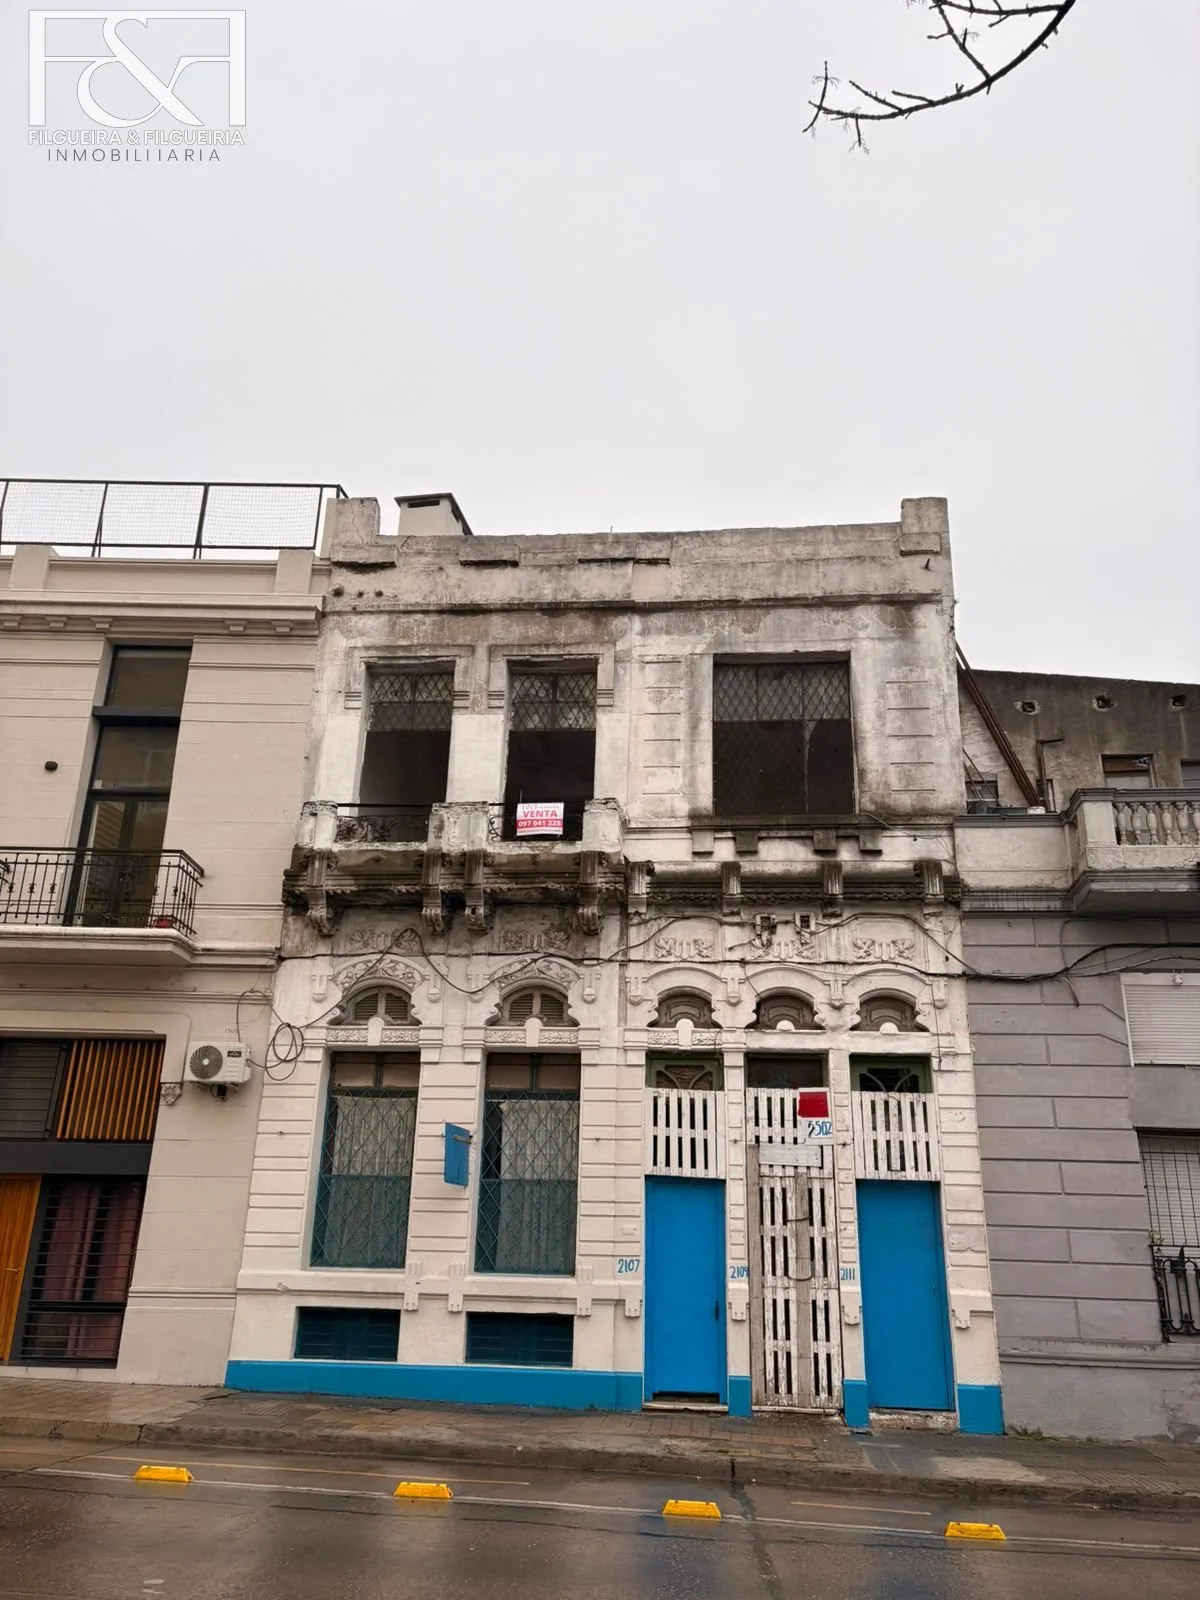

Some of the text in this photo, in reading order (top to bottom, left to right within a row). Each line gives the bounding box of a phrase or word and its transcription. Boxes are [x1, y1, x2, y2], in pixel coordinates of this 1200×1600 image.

[523, 810, 558, 818] VENTA
[617, 1258, 641, 1274] 2107
[729, 1265, 749, 1279] 2109
[840, 1267, 855, 1281] 2111
